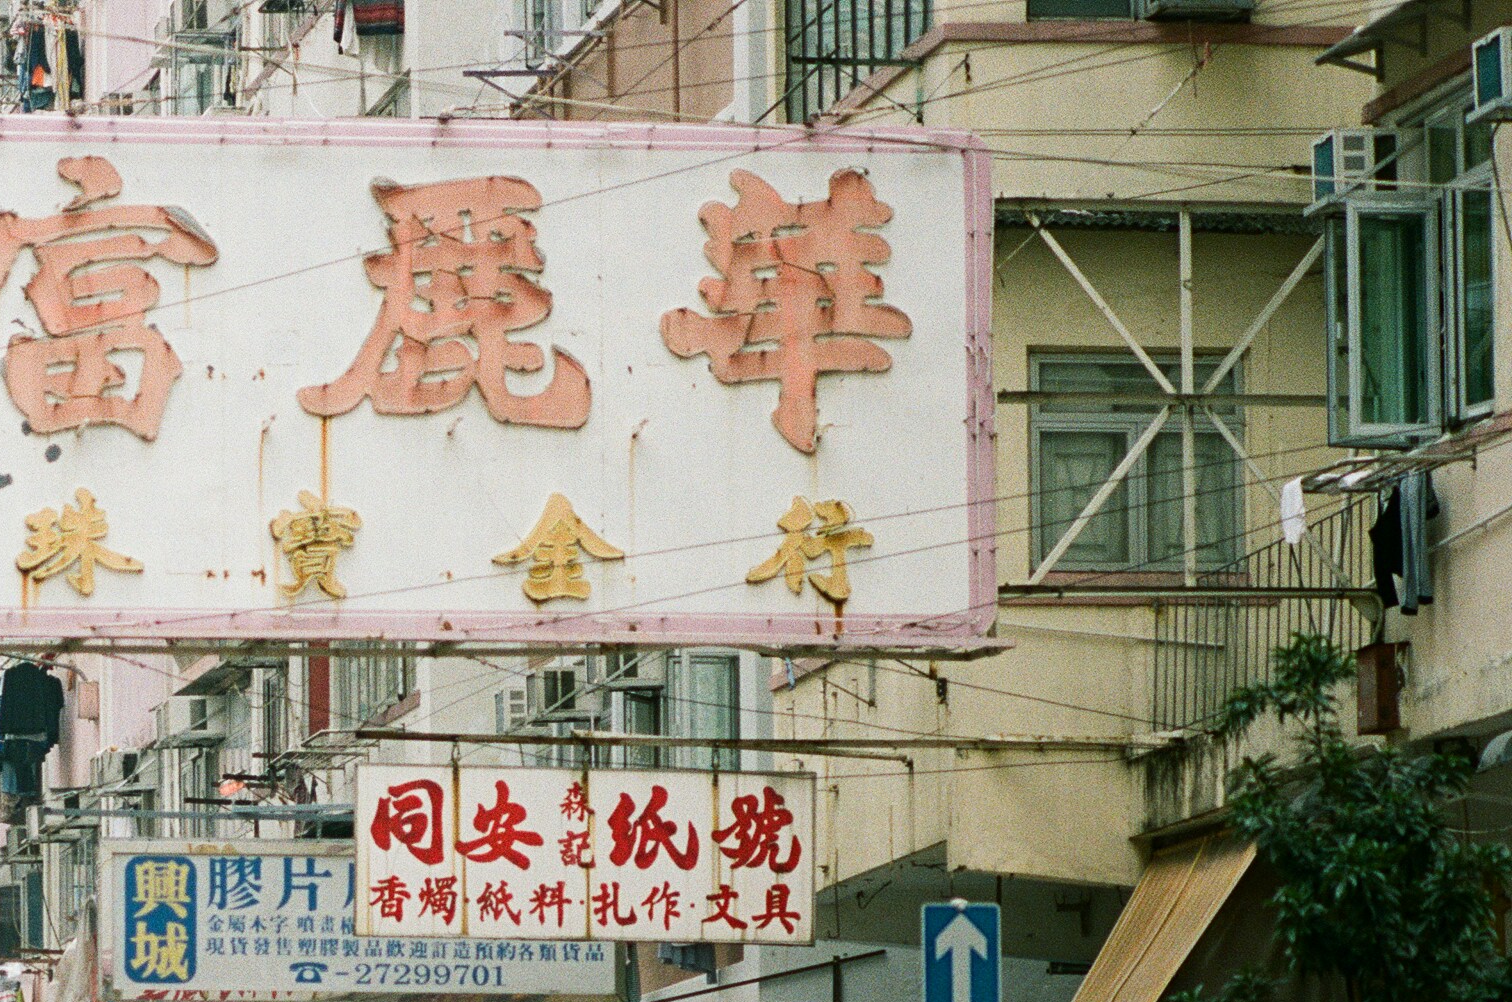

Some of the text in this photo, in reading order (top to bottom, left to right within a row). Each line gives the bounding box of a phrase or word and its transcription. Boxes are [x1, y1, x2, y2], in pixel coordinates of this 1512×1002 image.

[16, 487, 874, 602] 珠寶金行
[370, 780, 545, 871] 同安
[607, 786, 802, 873] 紙號
[131, 860, 190, 981] 興城
